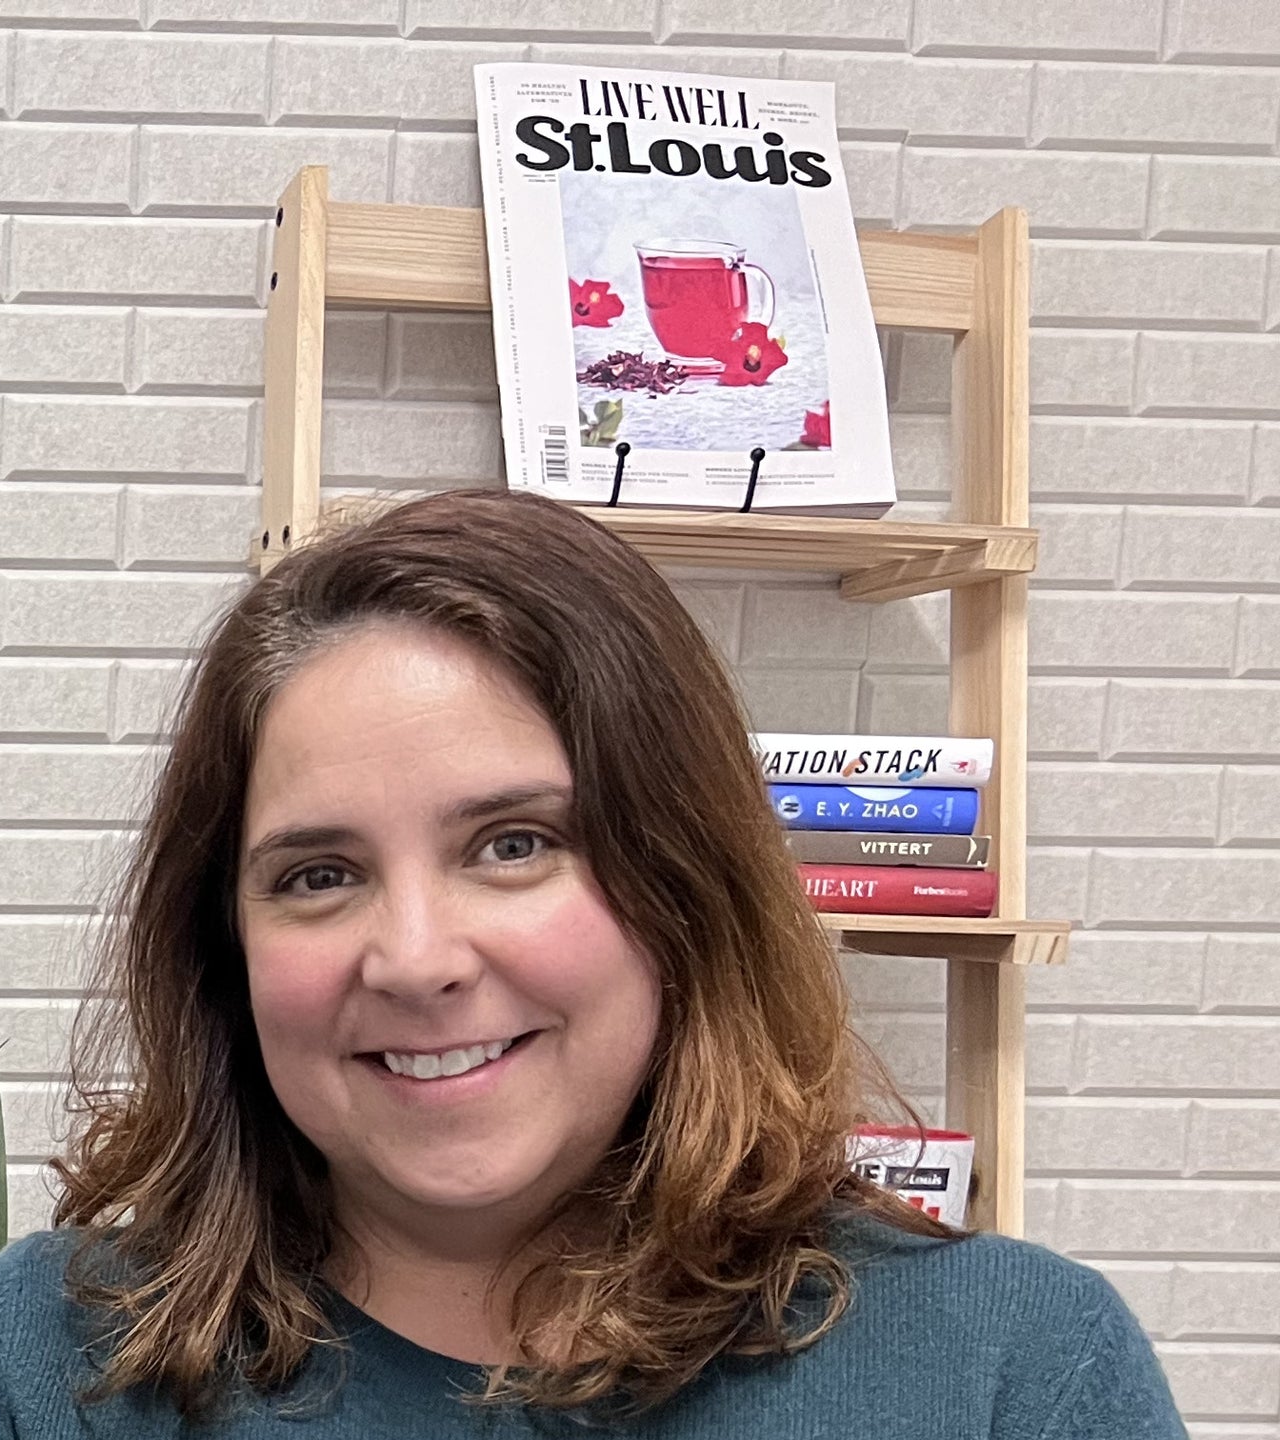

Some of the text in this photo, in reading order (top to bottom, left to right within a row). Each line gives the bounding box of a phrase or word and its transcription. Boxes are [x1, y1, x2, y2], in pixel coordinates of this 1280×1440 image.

[578, 79, 657, 120] LIVE
[662, 86, 759, 130] WELL
[855, 749, 942, 774] STACK
[816, 801, 918, 818] E. Y. ZHAO
[861, 841, 933, 855] VITTERT
[805, 879, 878, 897] HEART
